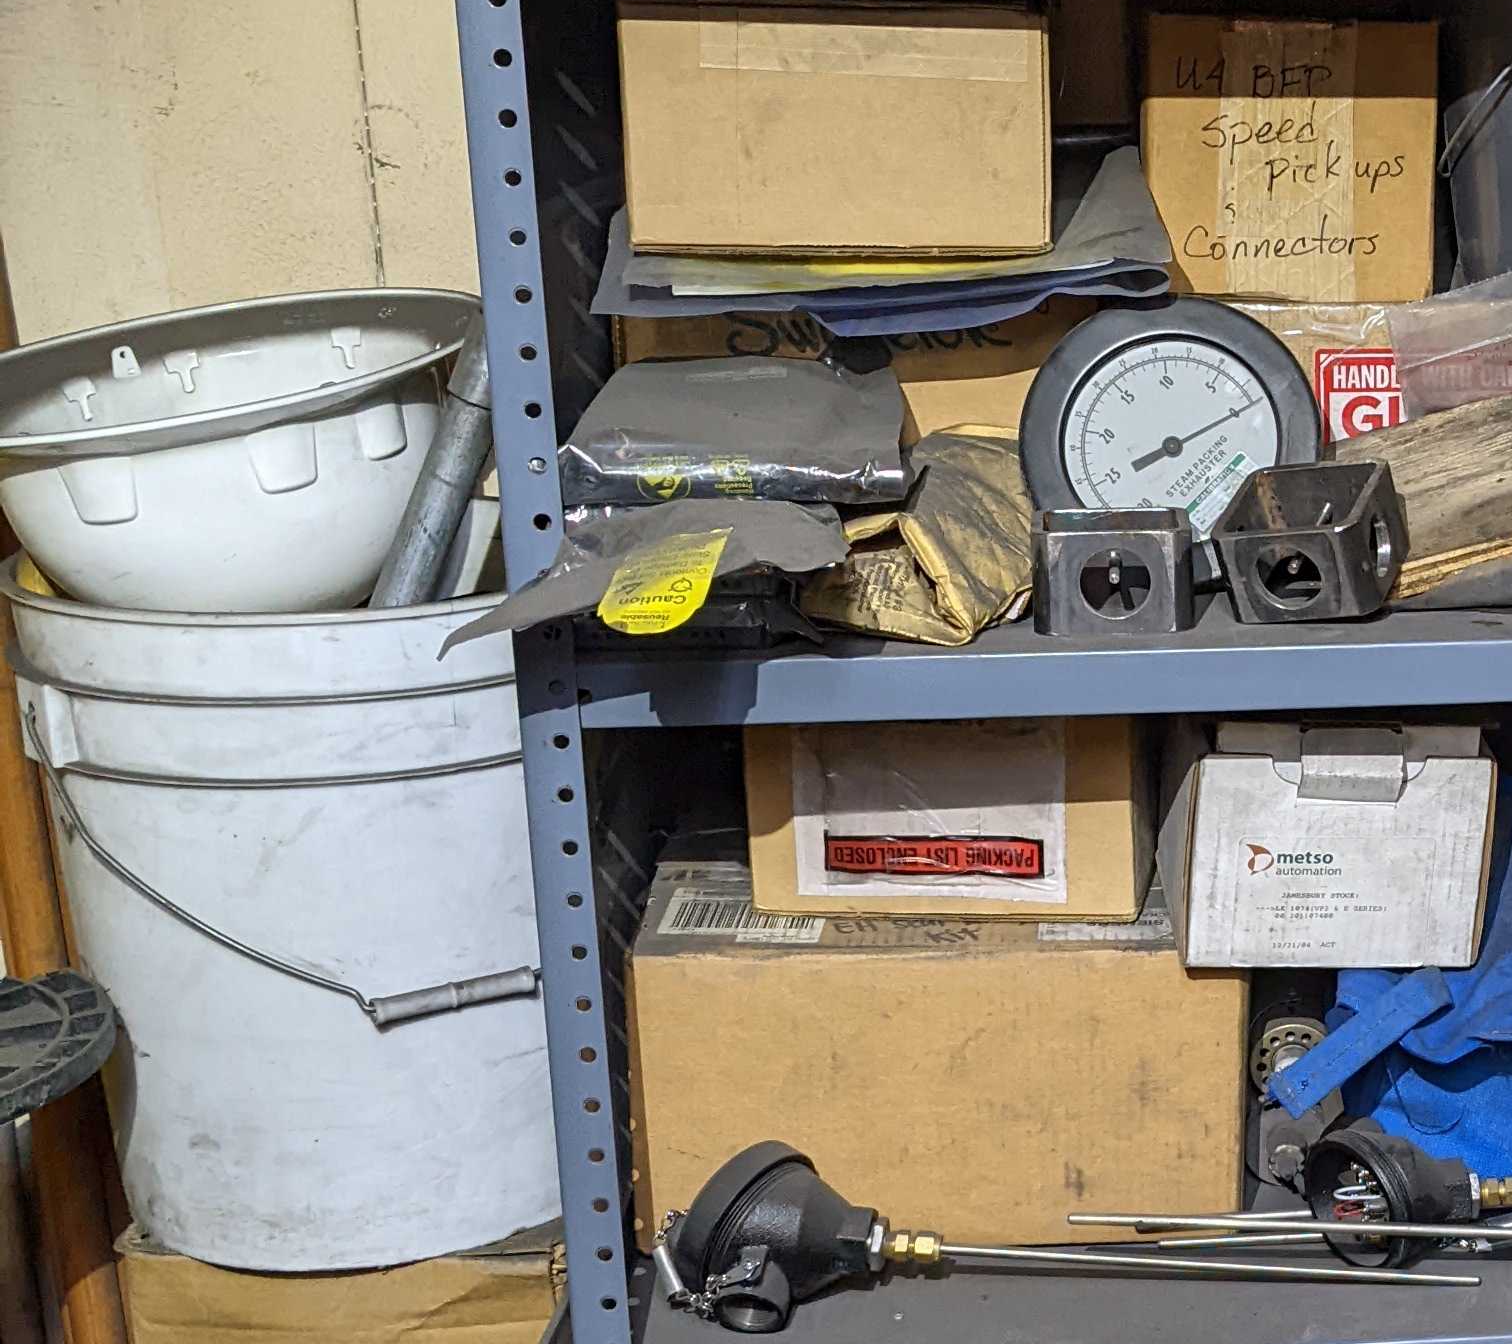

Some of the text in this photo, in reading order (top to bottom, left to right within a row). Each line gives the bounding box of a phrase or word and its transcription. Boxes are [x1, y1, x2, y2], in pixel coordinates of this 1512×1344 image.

[1200, 99, 1319, 162] Speed
[1354, 153, 1406, 194] ups
[1183, 215, 1379, 261] Connectors
[1159, 376, 1175, 390] 10
[1333, 365, 1401, 389] HANDL
[1207, 383, 1217, 394] 5
[1120, 390, 1135, 406] 15
[1099, 429, 1115, 444] 20
[1104, 468, 1122, 485] 25
[1179, 449, 1227, 497] EXHAUSTER
[1165, 467, 1195, 497] STEAM
[618, 595, 686, 605] Caution
[834, 846, 1034, 868] PACKING LIST ENCLOSED
[1277, 852, 1334, 864] metso
[1276, 866, 1342, 876] automation
